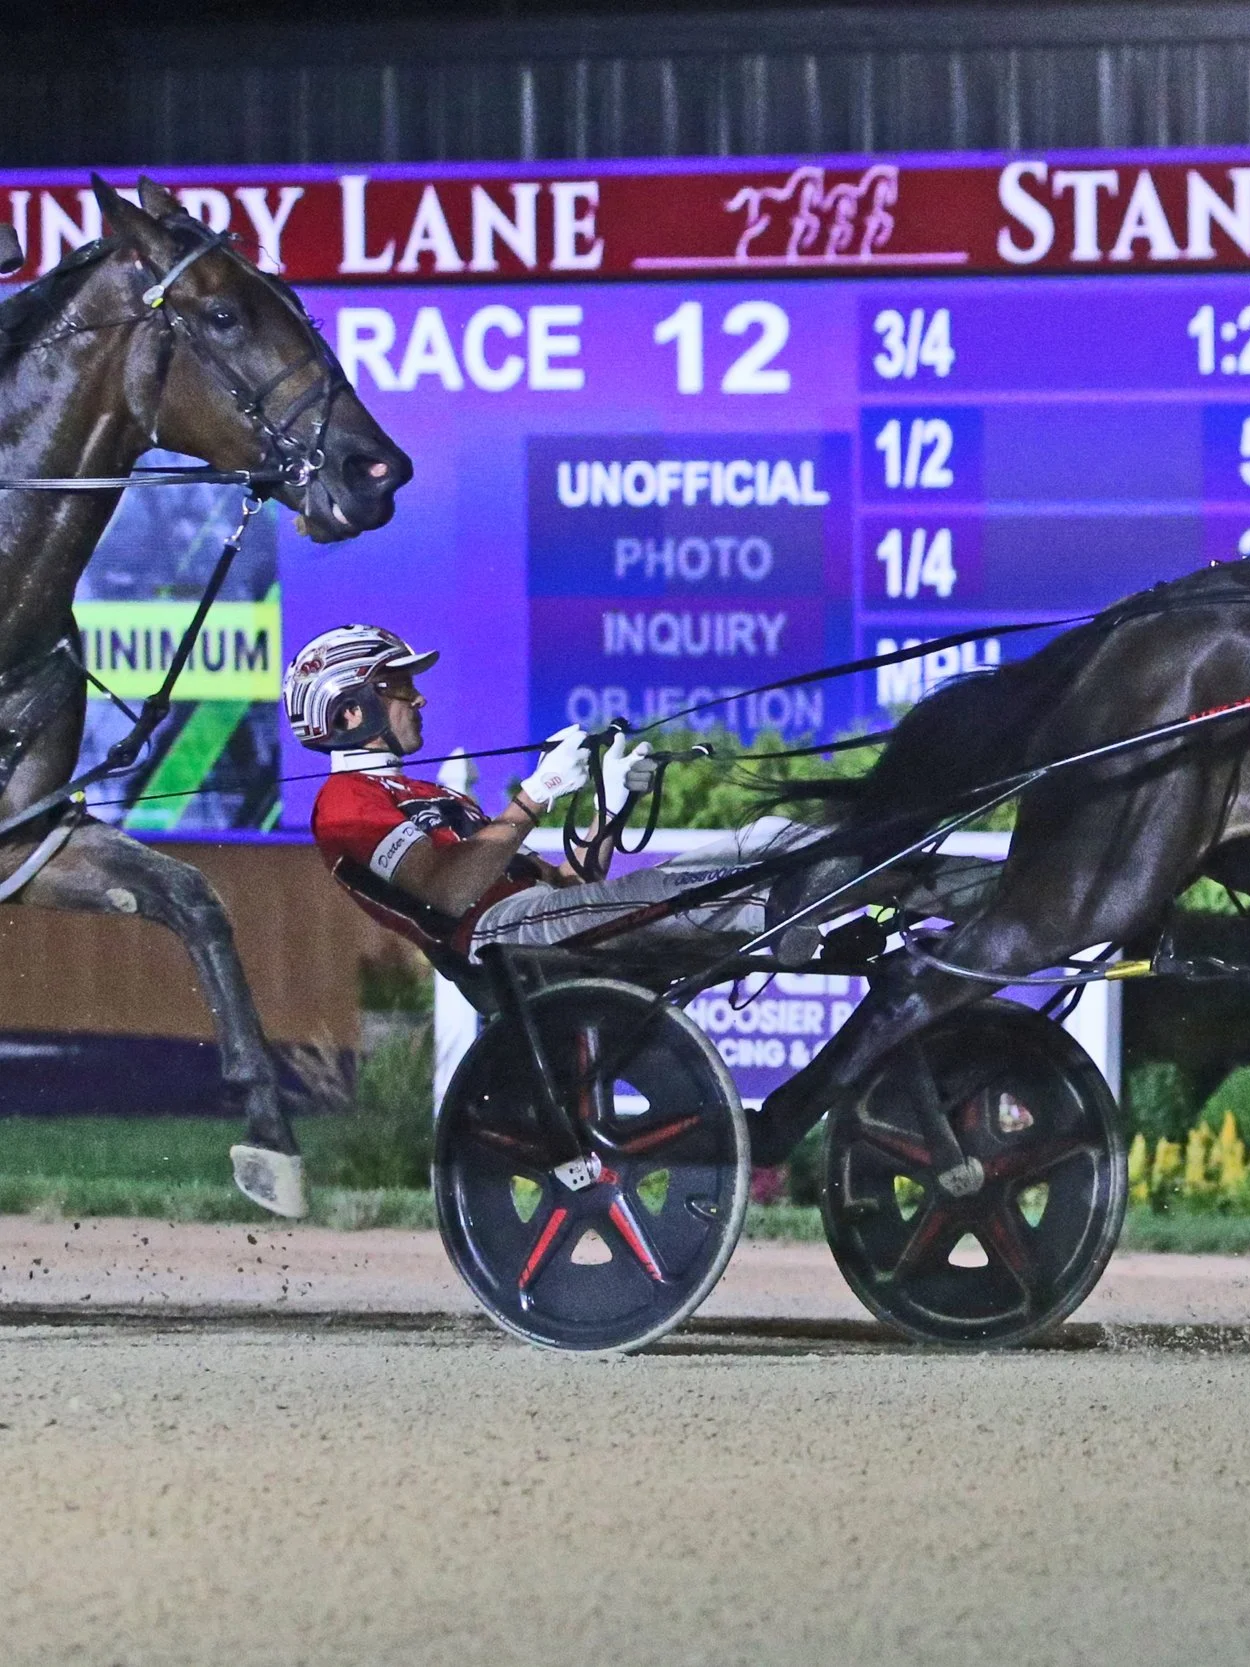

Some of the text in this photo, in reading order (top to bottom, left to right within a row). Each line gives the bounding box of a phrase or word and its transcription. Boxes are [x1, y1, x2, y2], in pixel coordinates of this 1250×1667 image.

[338, 174, 605, 271] LANE
[337, 301, 791, 394] RACE 12
[873, 309, 955, 378] 3/4
[557, 460, 830, 508] UNOFFICIAL
[875, 419, 954, 488] 1/2
[614, 537, 774, 582] PHOTO
[876, 527, 957, 600] 1/4
[602, 611, 788, 657] INQUIRY
[711, 1038, 786, 1069] CING
